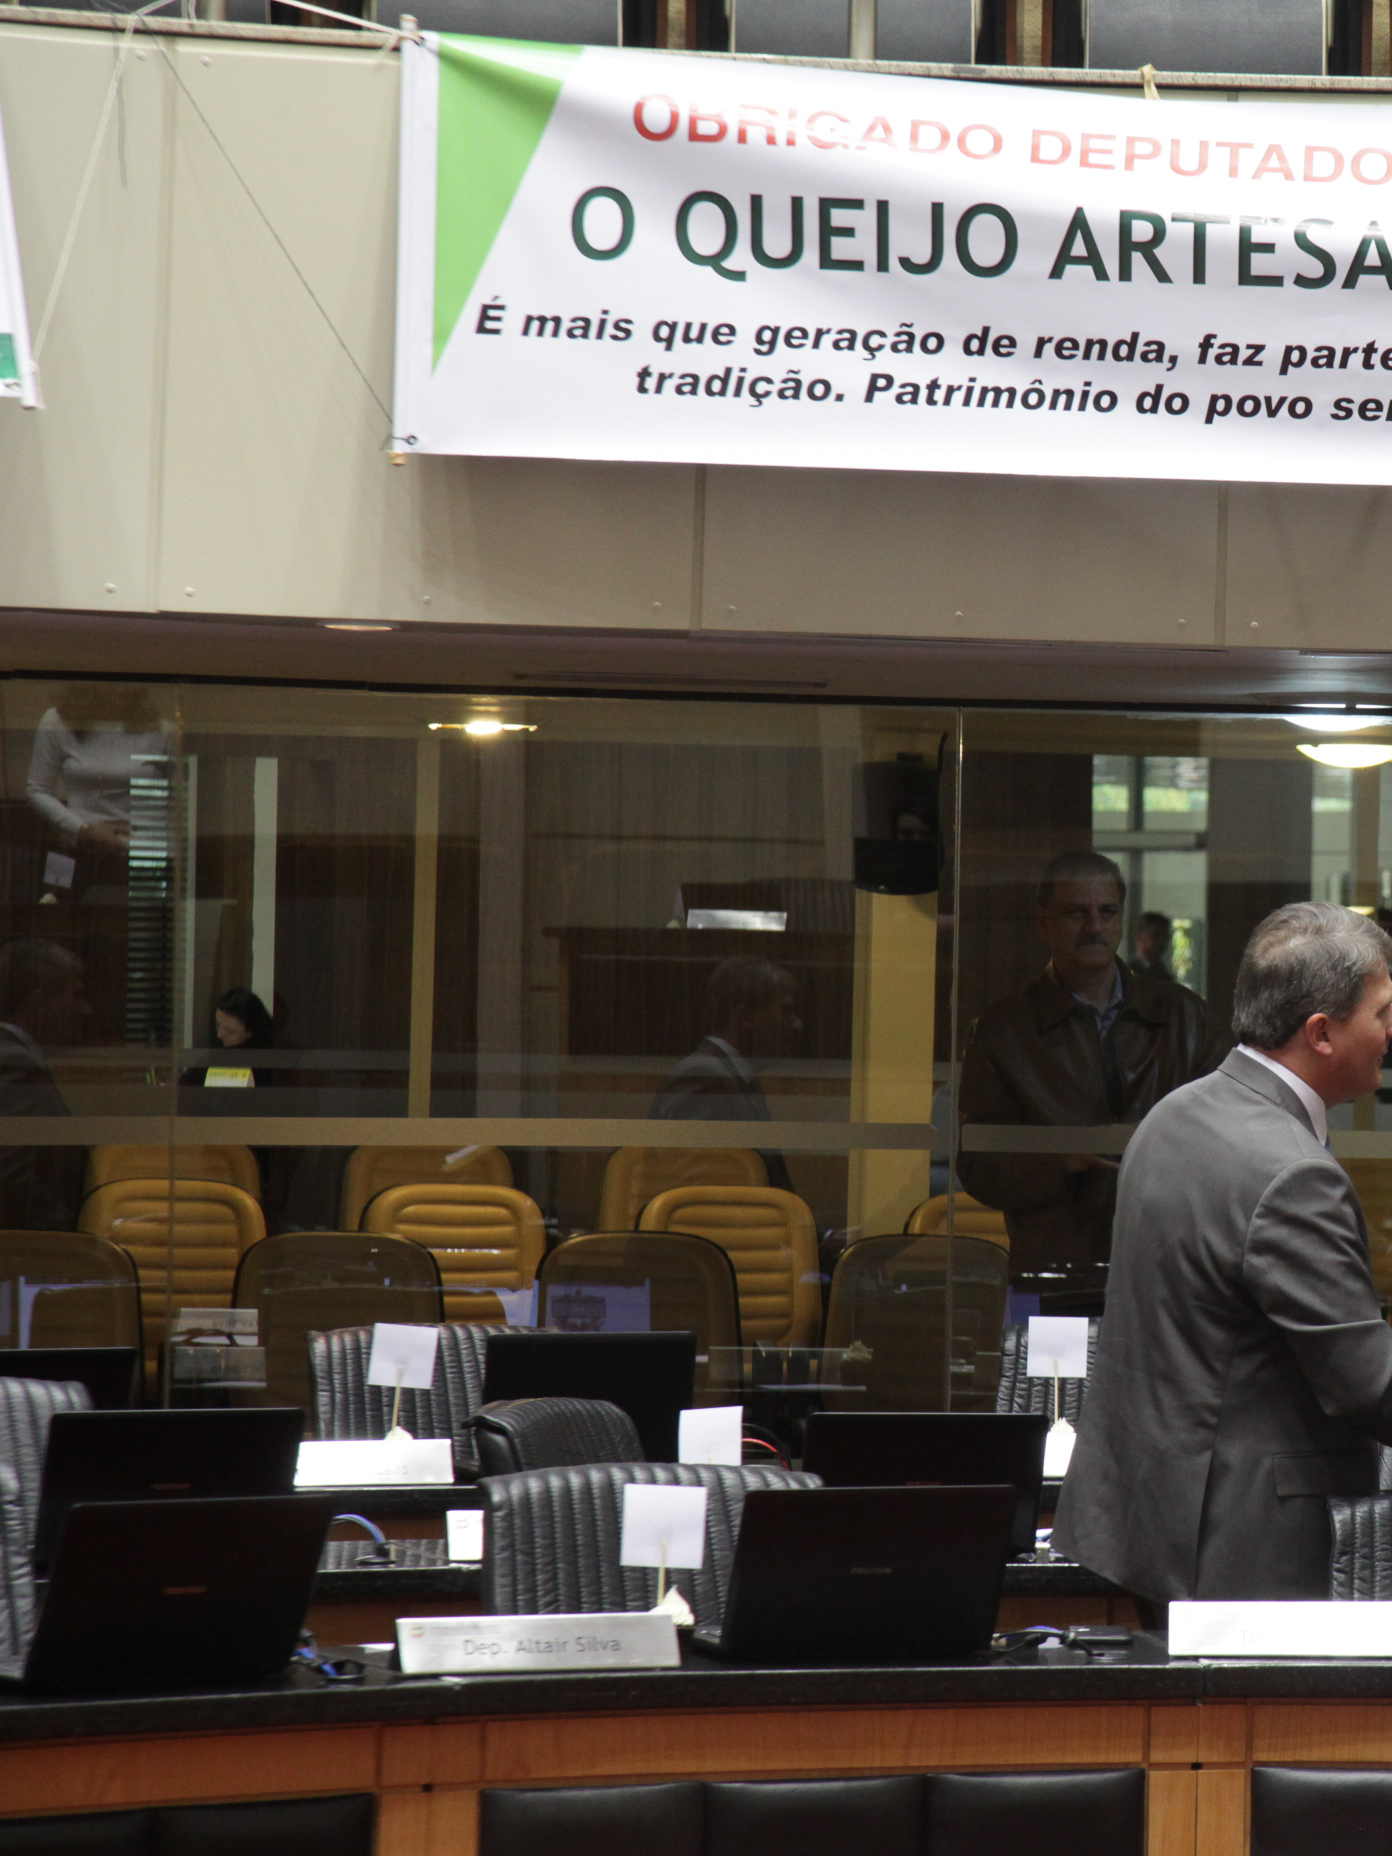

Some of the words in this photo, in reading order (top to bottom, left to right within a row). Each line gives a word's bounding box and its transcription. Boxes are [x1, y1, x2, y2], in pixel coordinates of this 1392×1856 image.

[633, 94, 1003, 160] OBRIGADO
[571, 186, 635, 261] O
[675, 190, 1019, 282] QUEIJO
[475, 296, 508, 335] É
[522, 314, 634, 341] mais
[652, 320, 737, 352] que
[753, 322, 945, 360] geração
[962, 325, 1018, 358] de
[1033, 331, 1179, 372] renda,
[1197, 334, 1266, 367] faz
[637, 365, 844, 407] tradição.
[864, 373, 1119, 413] Patrimônio
[1135, 383, 1190, 416] do
[1204, 393, 1314, 425] povo
[462, 1638, 508, 1658] Dep.
[515, 1637, 569, 1655] Altair
[575, 1635, 622, 1654] Silva
